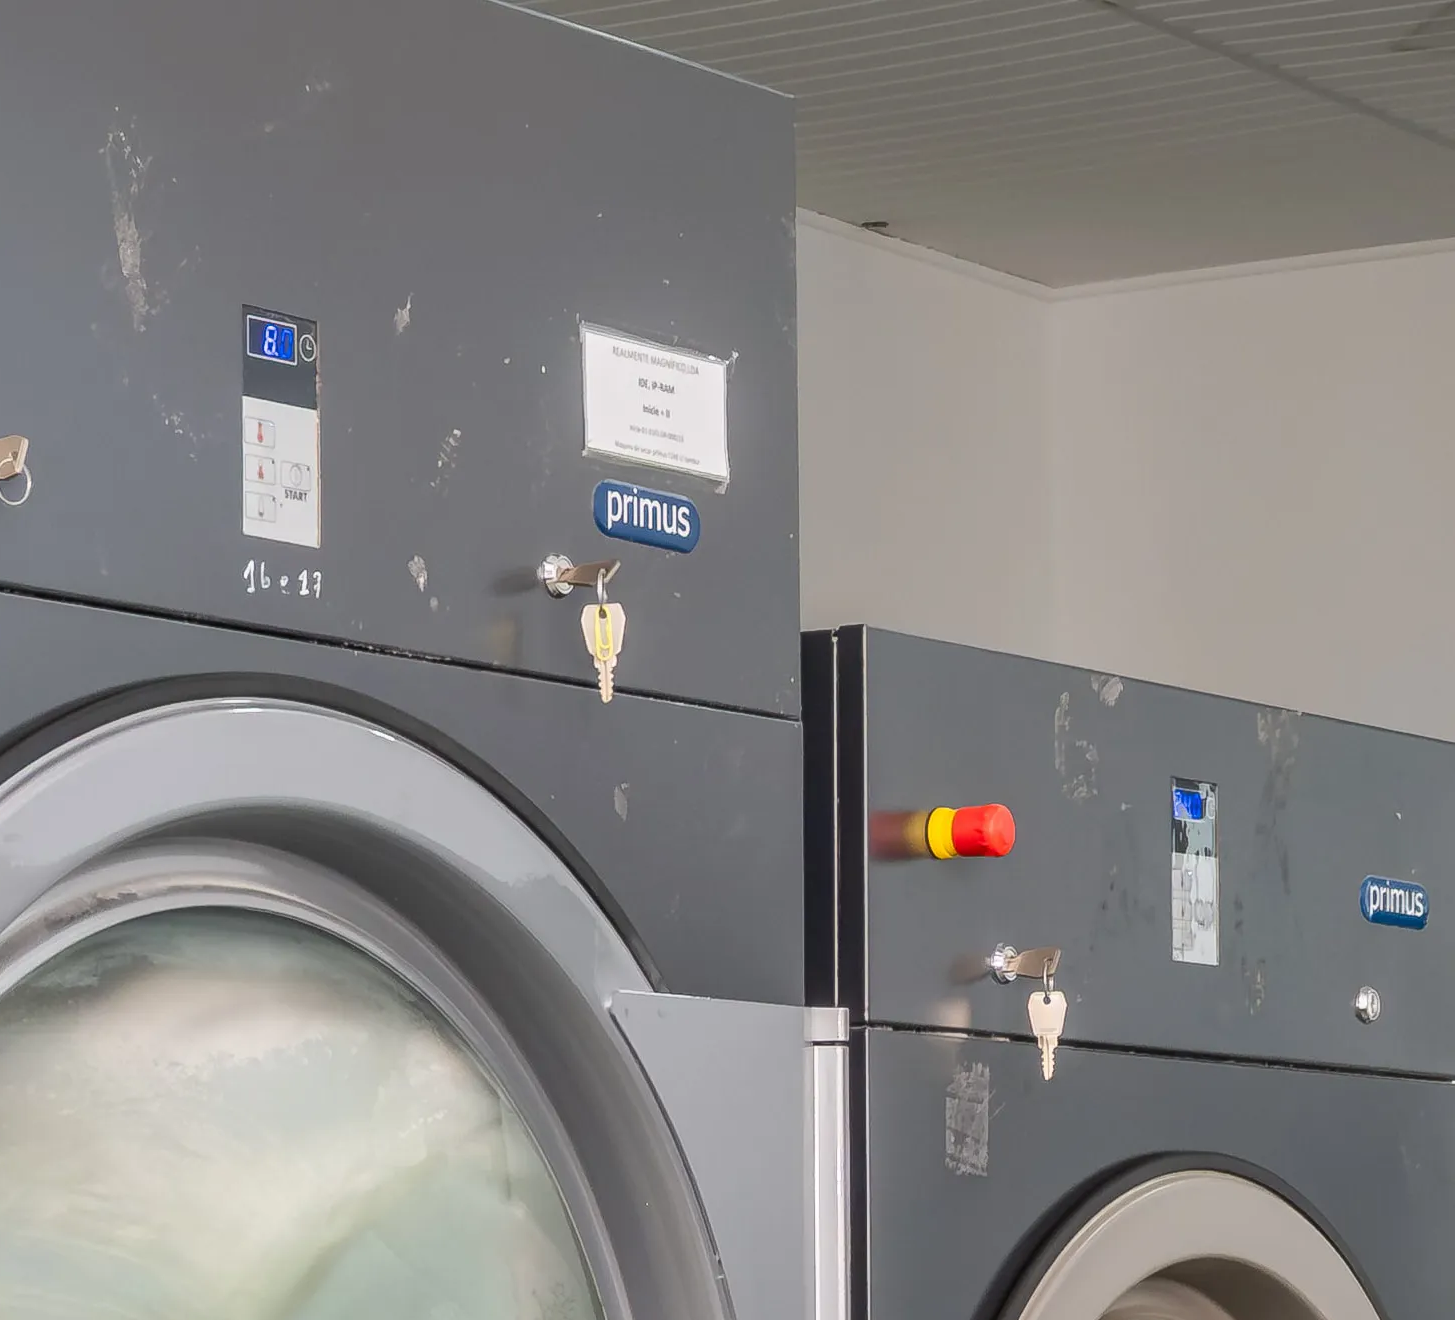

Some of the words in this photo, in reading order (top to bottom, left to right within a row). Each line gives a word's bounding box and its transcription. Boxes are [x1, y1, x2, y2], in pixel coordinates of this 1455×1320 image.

[284, 488, 308, 503] START
[607, 487, 691, 537] primus
[1369, 880, 1425, 920] primus
